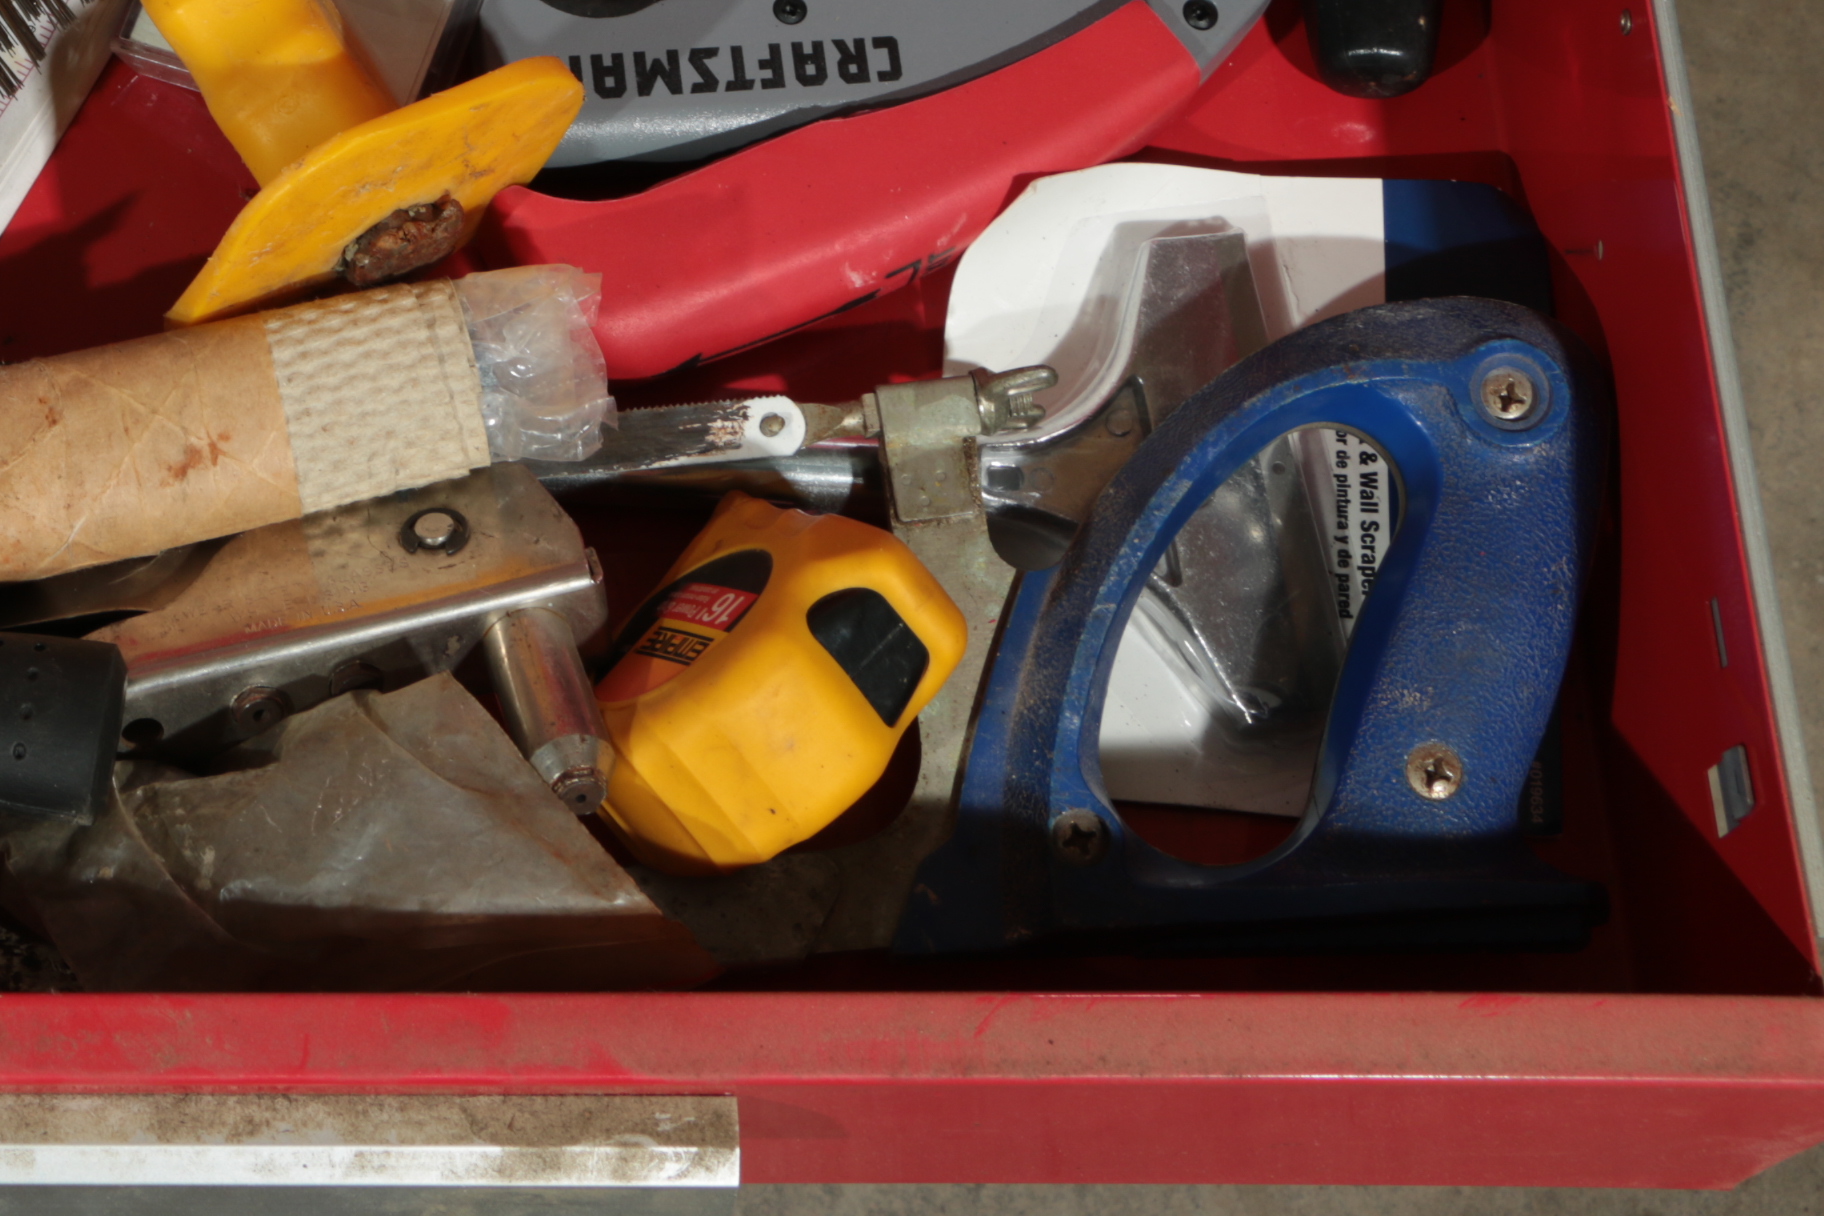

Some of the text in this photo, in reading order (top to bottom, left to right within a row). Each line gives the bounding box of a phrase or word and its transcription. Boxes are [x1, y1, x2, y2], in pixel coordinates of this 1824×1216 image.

[1335, 449, 1351, 469] de
[1358, 449, 1378, 466] &
[1330, 472, 1354, 530] pintura
[1355, 470, 1382, 515] Wall
[1333, 533, 1348, 545] y
[1335, 548, 1353, 568] de
[1333, 572, 1354, 620] pared
